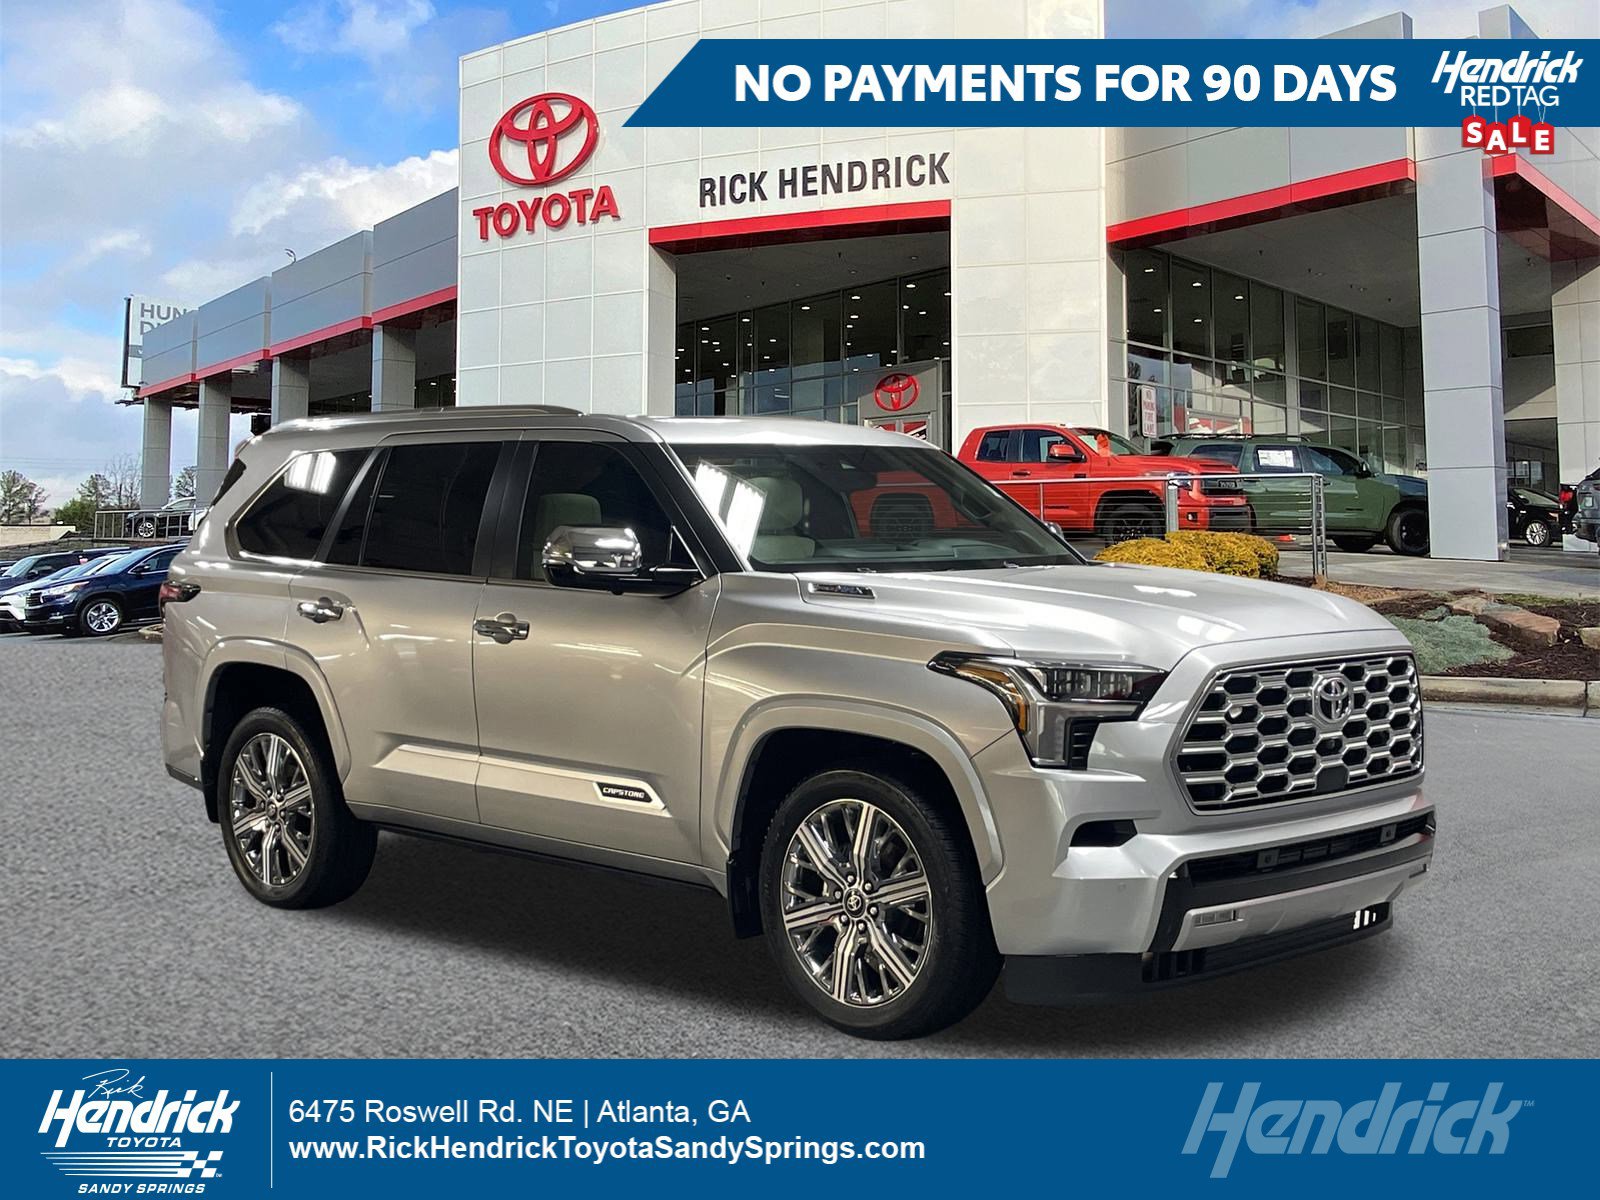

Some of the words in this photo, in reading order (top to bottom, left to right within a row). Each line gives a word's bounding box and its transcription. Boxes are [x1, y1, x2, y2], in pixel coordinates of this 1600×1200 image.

[699, 170, 768, 208] RICK
[779, 152, 950, 199] HENDRICK
[473, 185, 620, 241] TOYOTA
[602, 787, 645, 799] CAPSTONE
